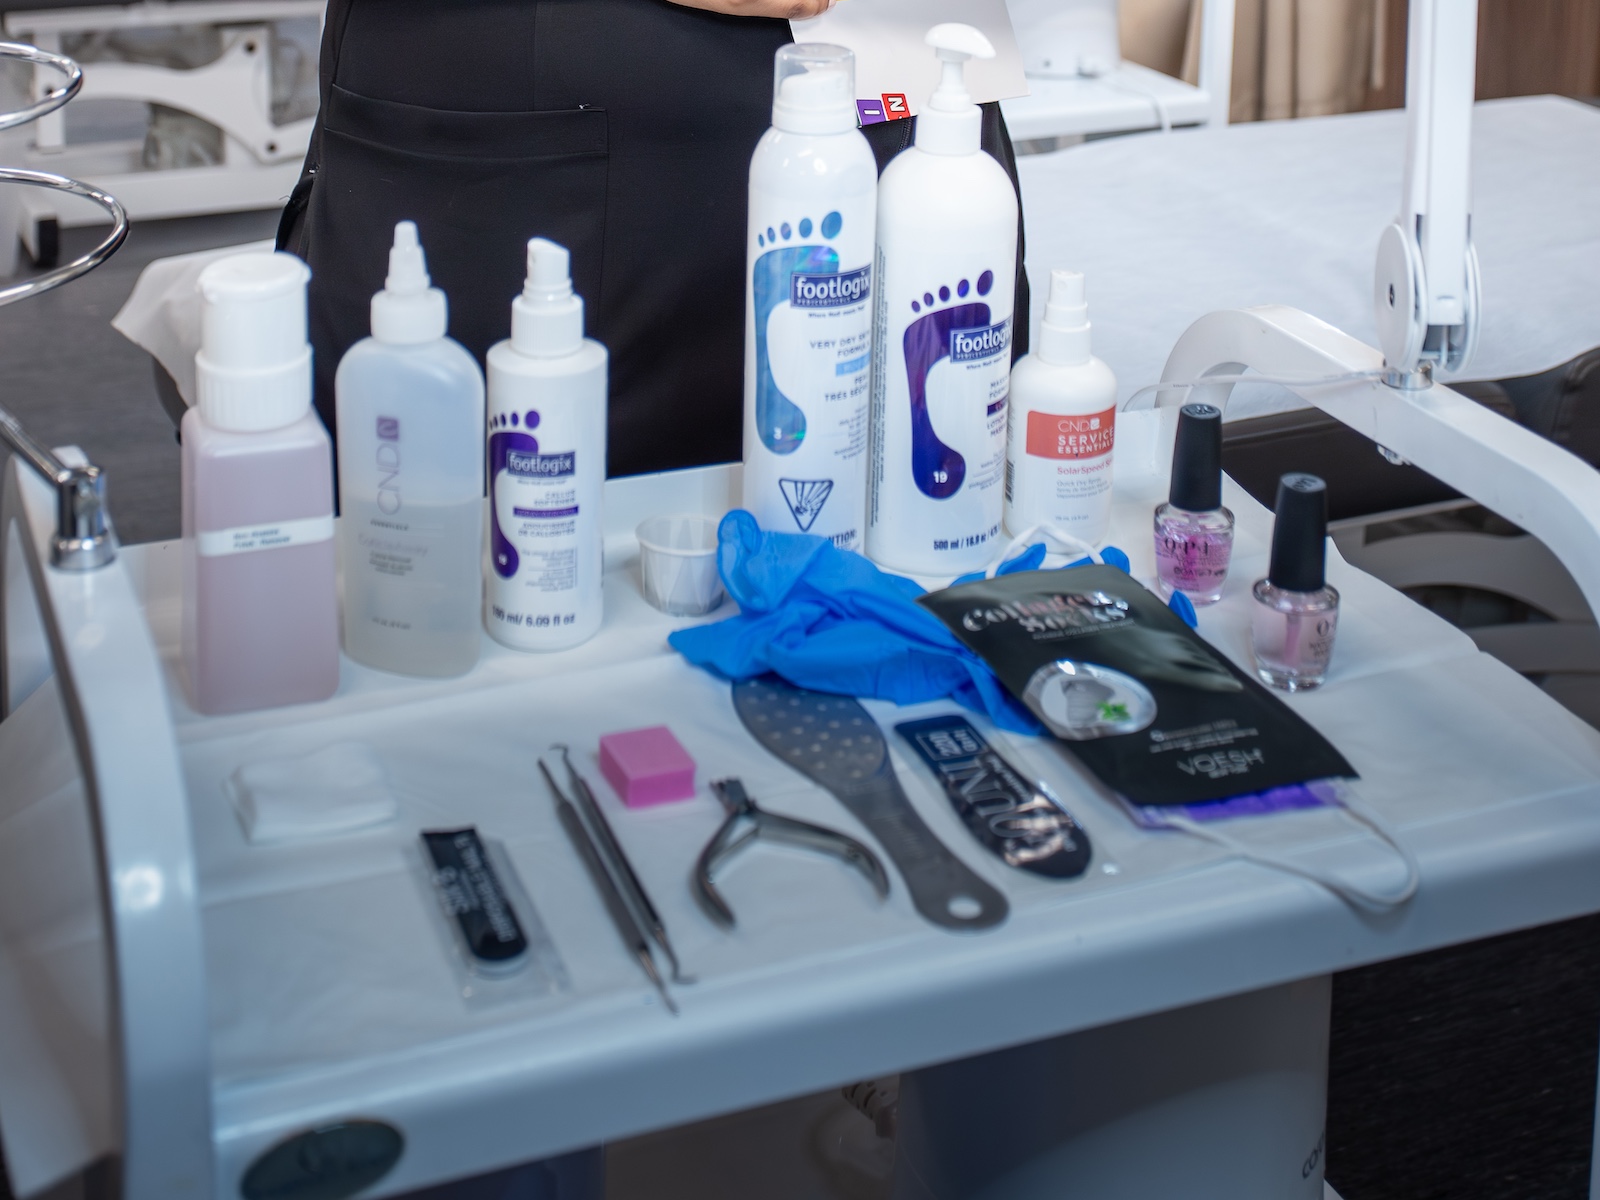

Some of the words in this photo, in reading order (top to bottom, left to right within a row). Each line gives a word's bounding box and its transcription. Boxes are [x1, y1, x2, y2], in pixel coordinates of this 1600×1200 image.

[1057, 419, 1090, 433] CND
[1057, 427, 1114, 446] SERVICE
[509, 452, 571, 476] footlogix
[376, 442, 401, 516] CND
[933, 471, 948, 483] 19
[933, 540, 948, 551] 500
[1176, 748, 1264, 776] VOESH
